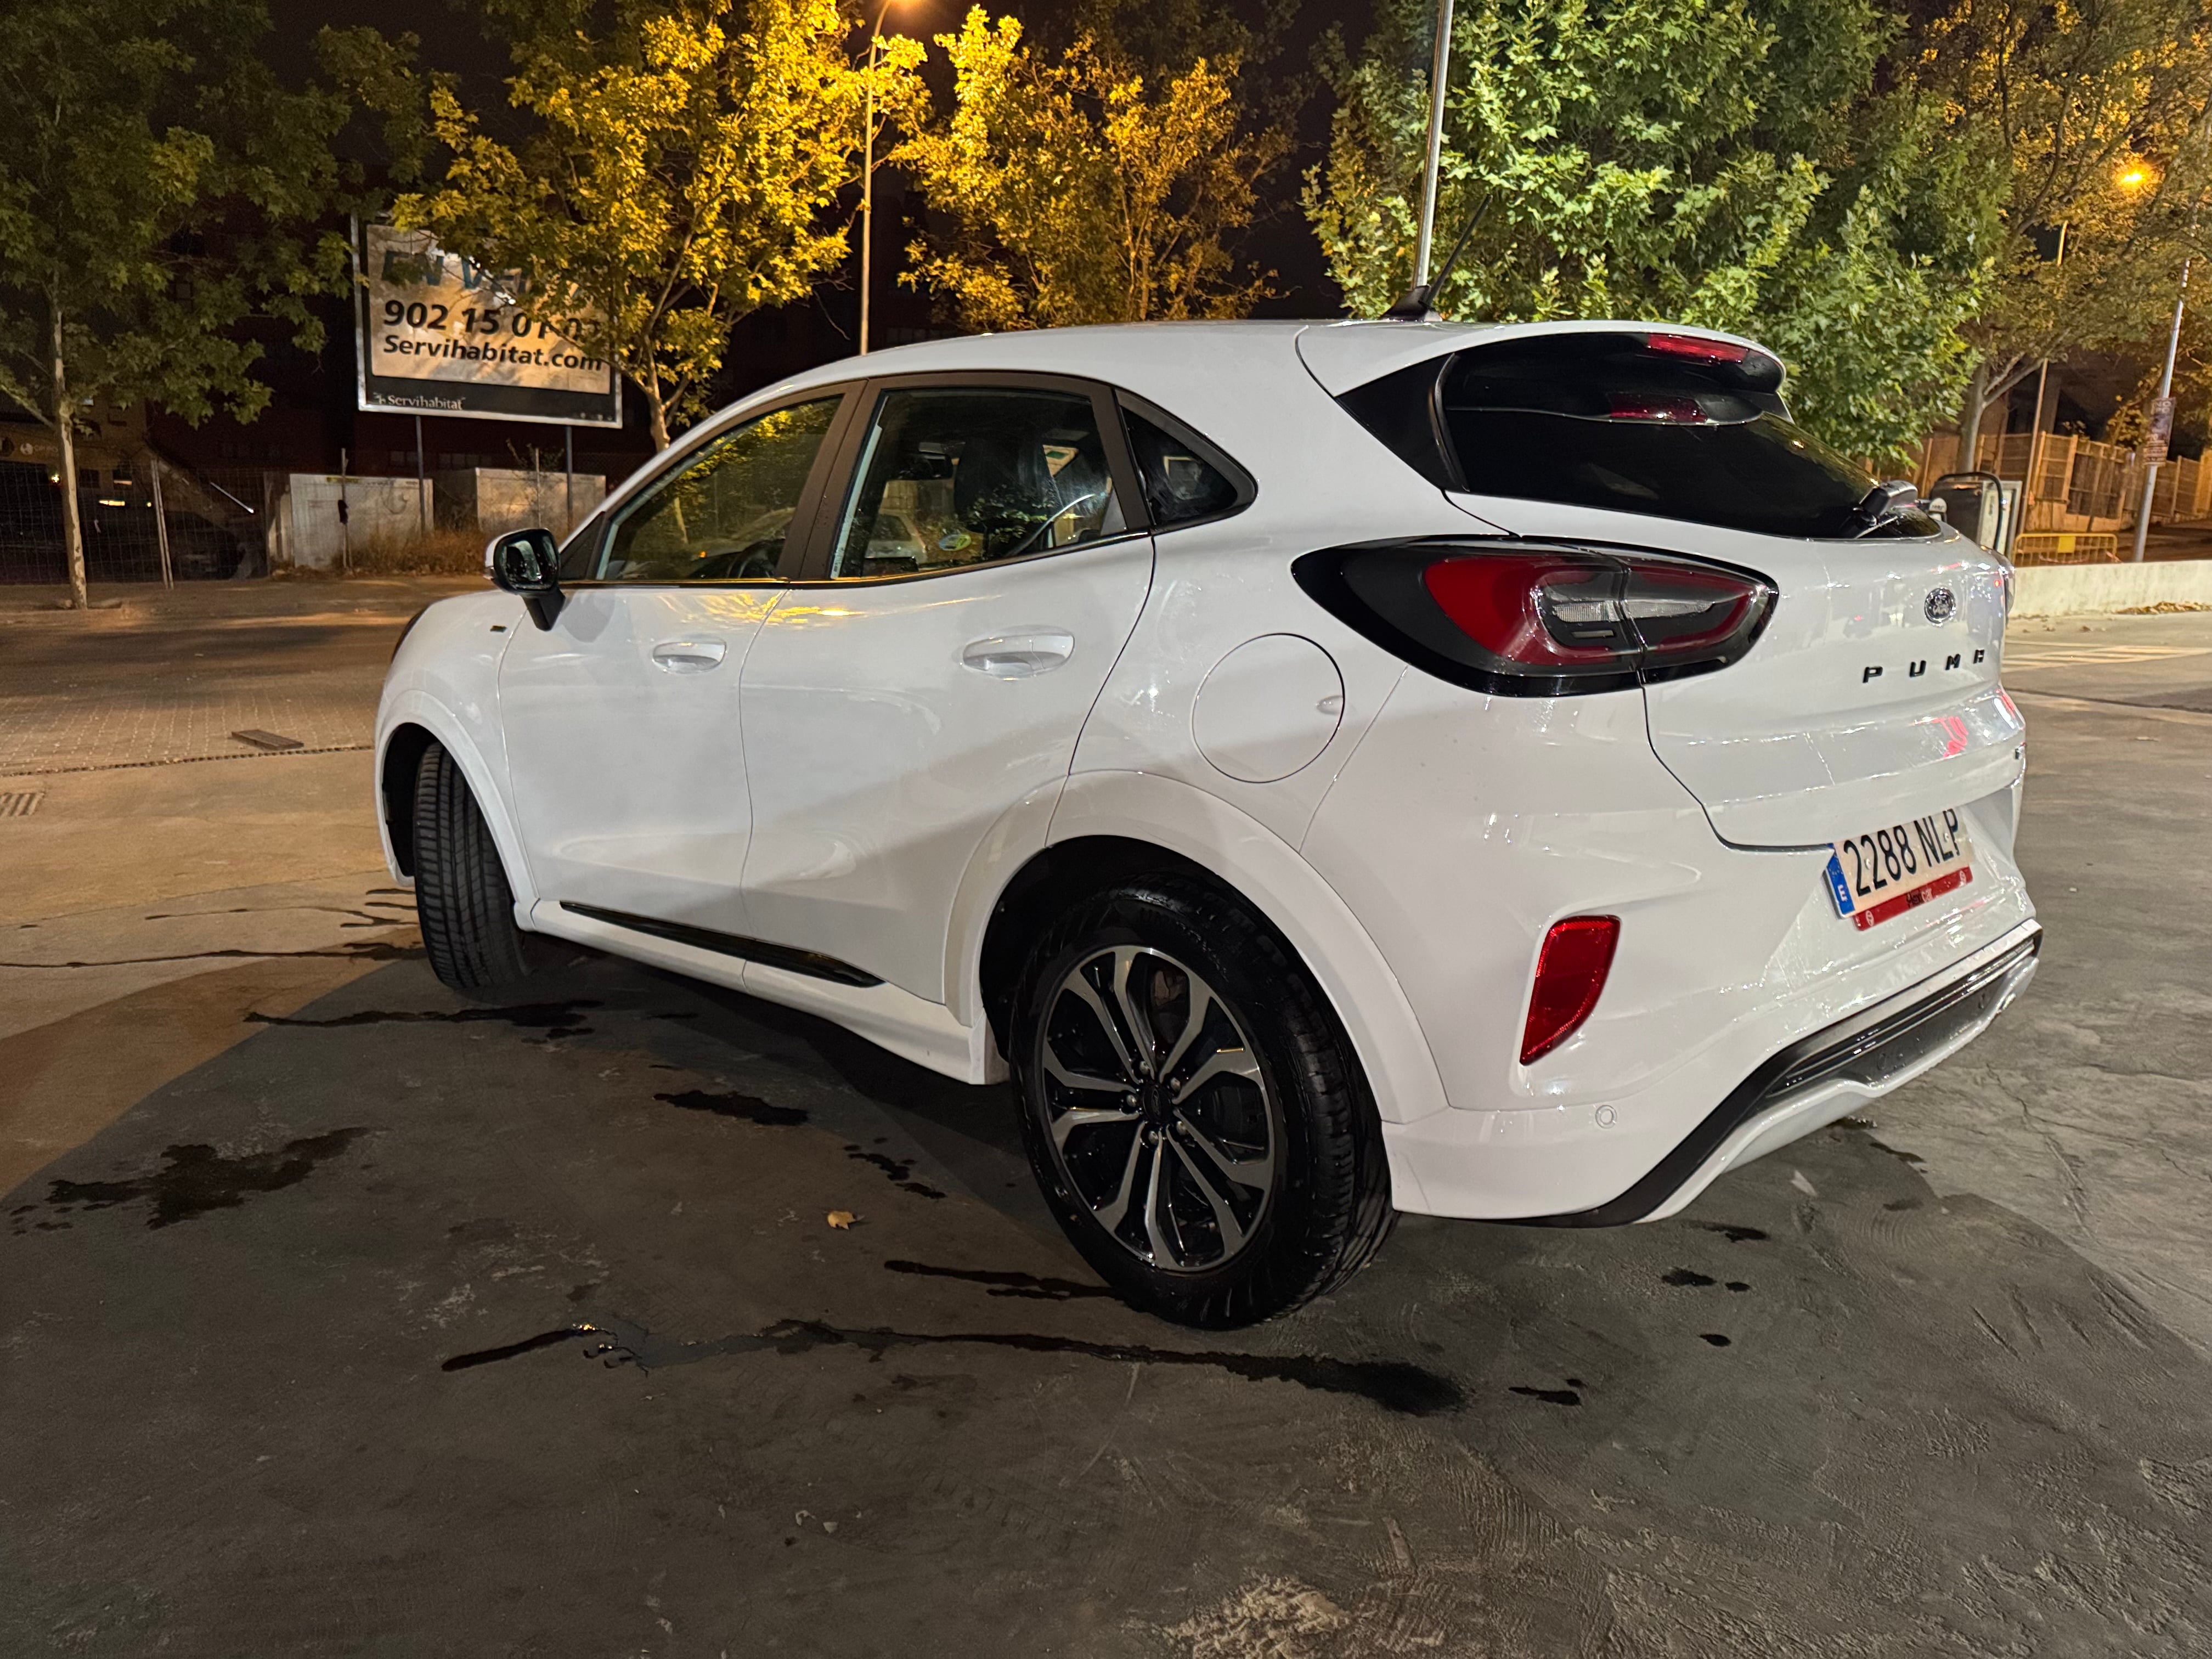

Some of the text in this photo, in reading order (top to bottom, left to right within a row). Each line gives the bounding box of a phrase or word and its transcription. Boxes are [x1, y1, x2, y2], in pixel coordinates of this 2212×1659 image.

[384, 300, 448, 330] 902
[462, 308, 500, 335] 15
[383, 335, 602, 371] Servihabitat.com
[387, 394, 462, 410] Servihabitat
[1863, 650, 1985, 684] PUMA
[1843, 808, 1960, 897] 2288 NLP
[1837, 884, 1847, 901] E
